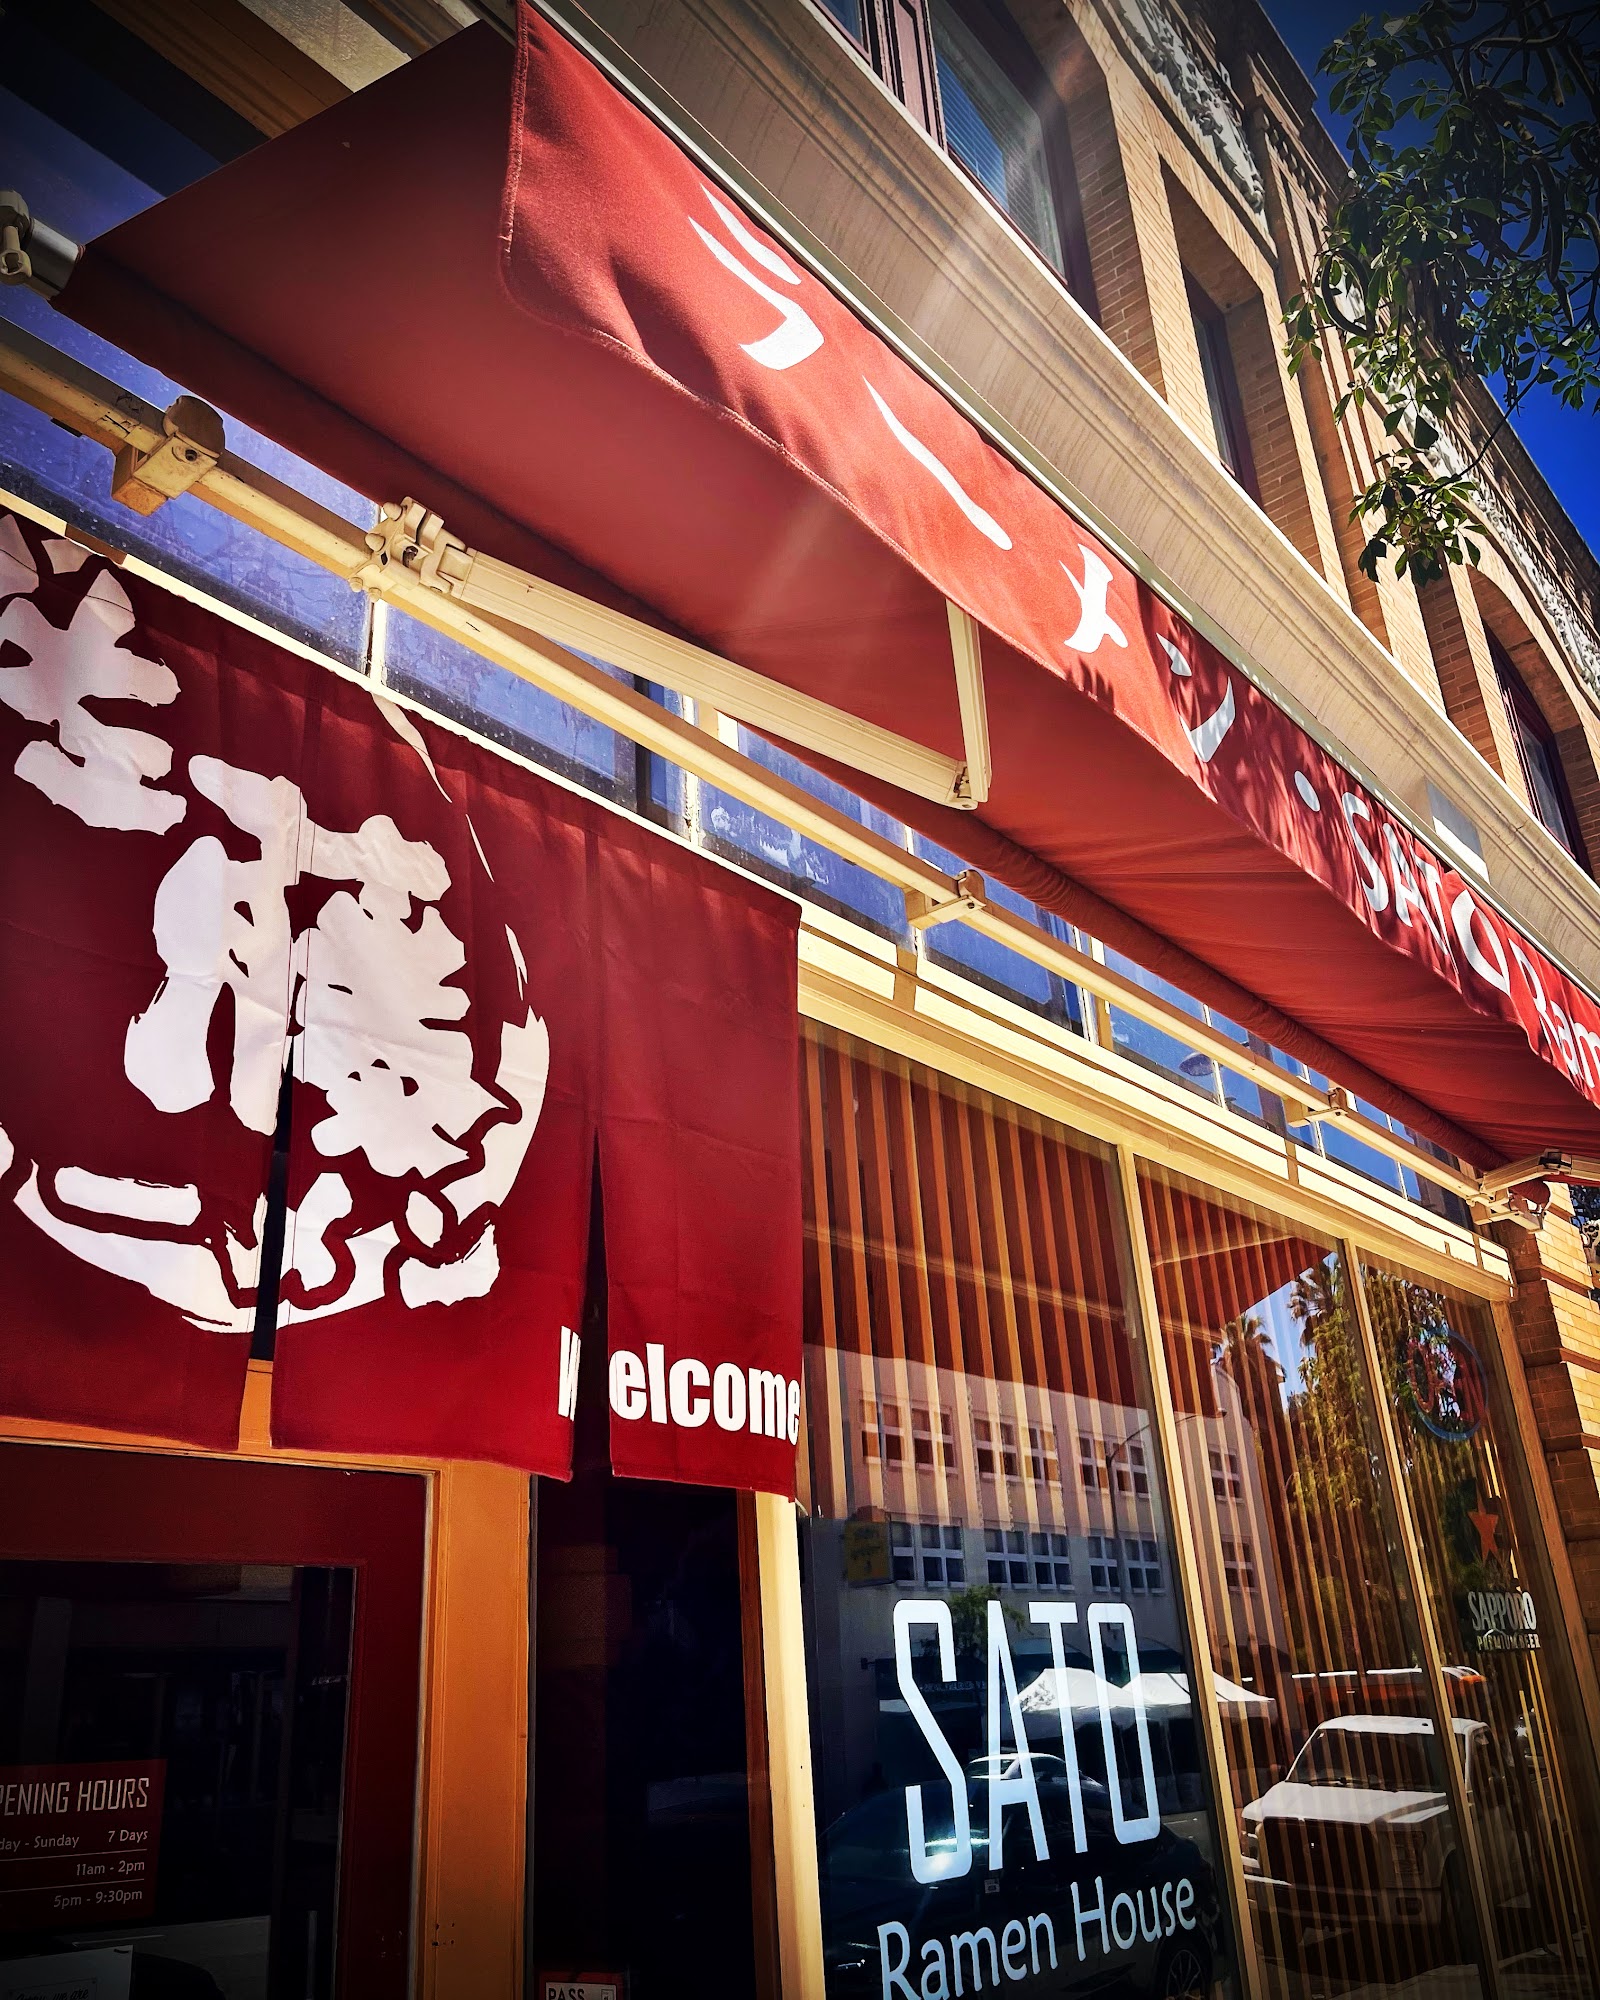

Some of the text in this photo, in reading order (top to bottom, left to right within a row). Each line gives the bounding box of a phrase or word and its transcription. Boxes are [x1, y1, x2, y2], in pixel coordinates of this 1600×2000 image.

[688, 182, 1236, 763] ラーメン
[1342, 792, 1511, 998] SATO
[1467, 1591, 1537, 1631] SAPPORO
[894, 1599, 1160, 1884] SATO
[77, 1777, 149, 1812] HOURS
[34, 1834, 80, 1849] Sunday
[108, 1830, 115, 1843] 7
[119, 1829, 149, 1844] Days
[76, 1863, 105, 1876] 11am
[118, 1860, 145, 1875] 2pm
[53, 1894, 82, 1910] 5pm
[95, 1889, 143, 1905] 9:30pm
[877, 1876, 1197, 2000] Ramen House
